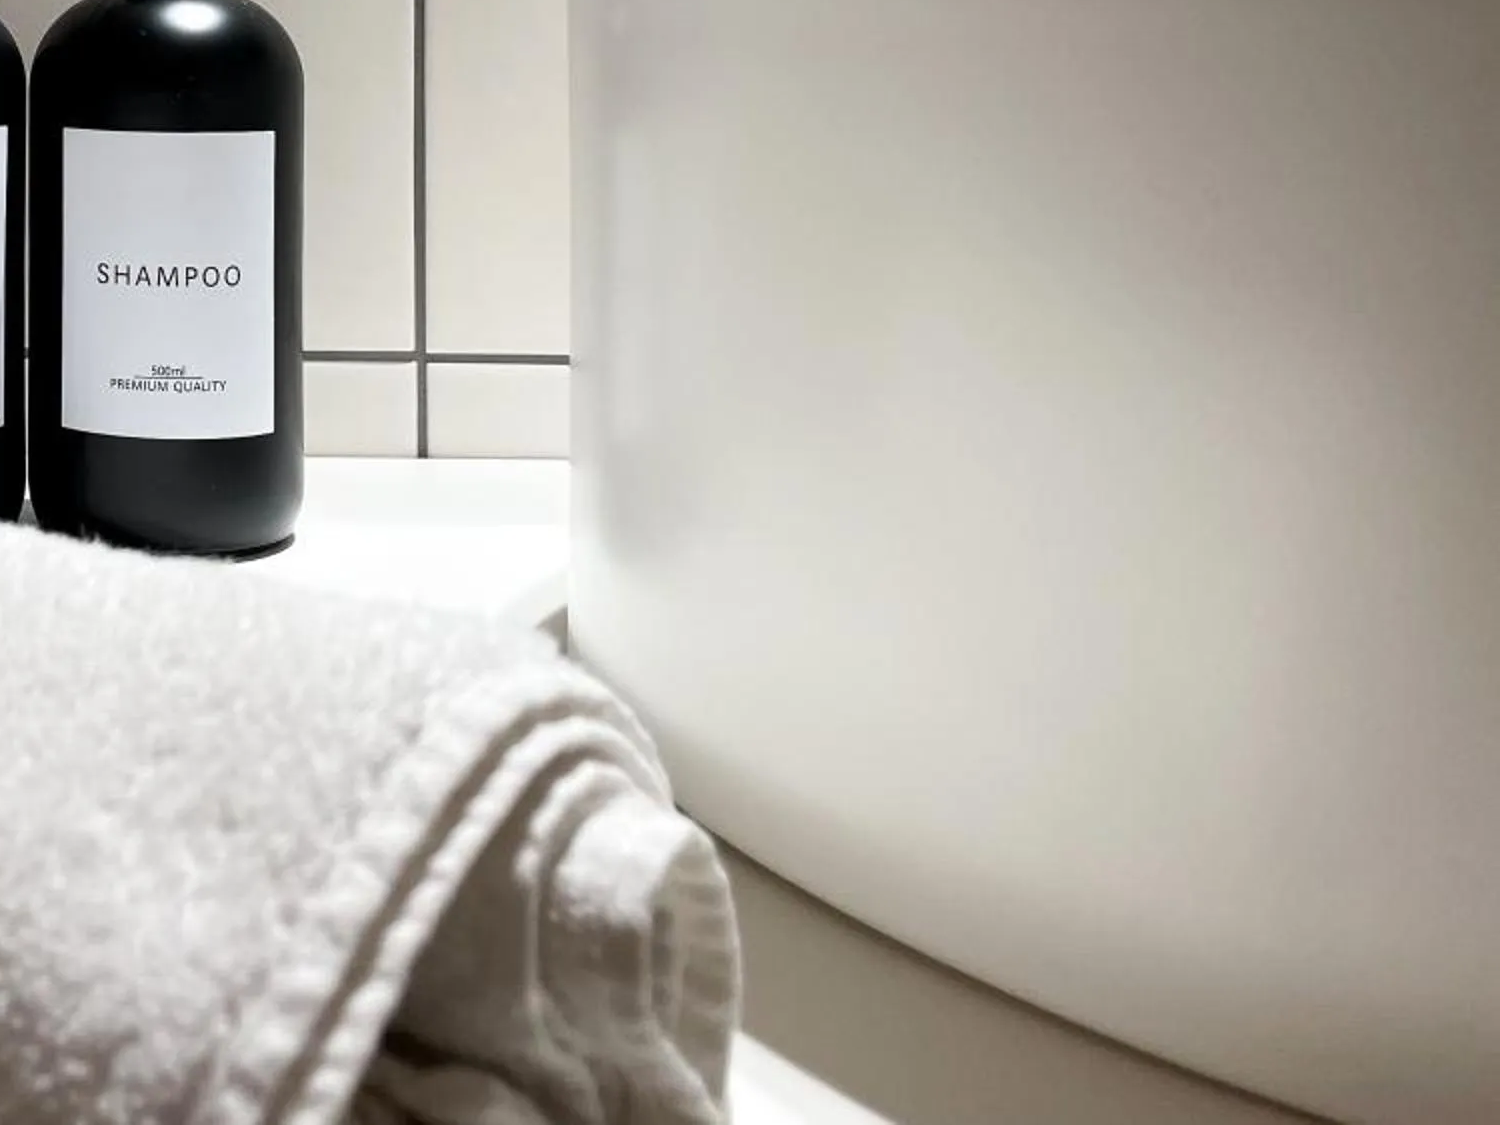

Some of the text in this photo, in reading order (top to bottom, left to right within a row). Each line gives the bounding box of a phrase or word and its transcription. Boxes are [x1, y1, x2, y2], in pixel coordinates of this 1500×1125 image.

[96, 262, 242, 288] SHAMPOO
[150, 364, 186, 376] 500ml
[109, 378, 227, 394] PREMIUM QUALITY
